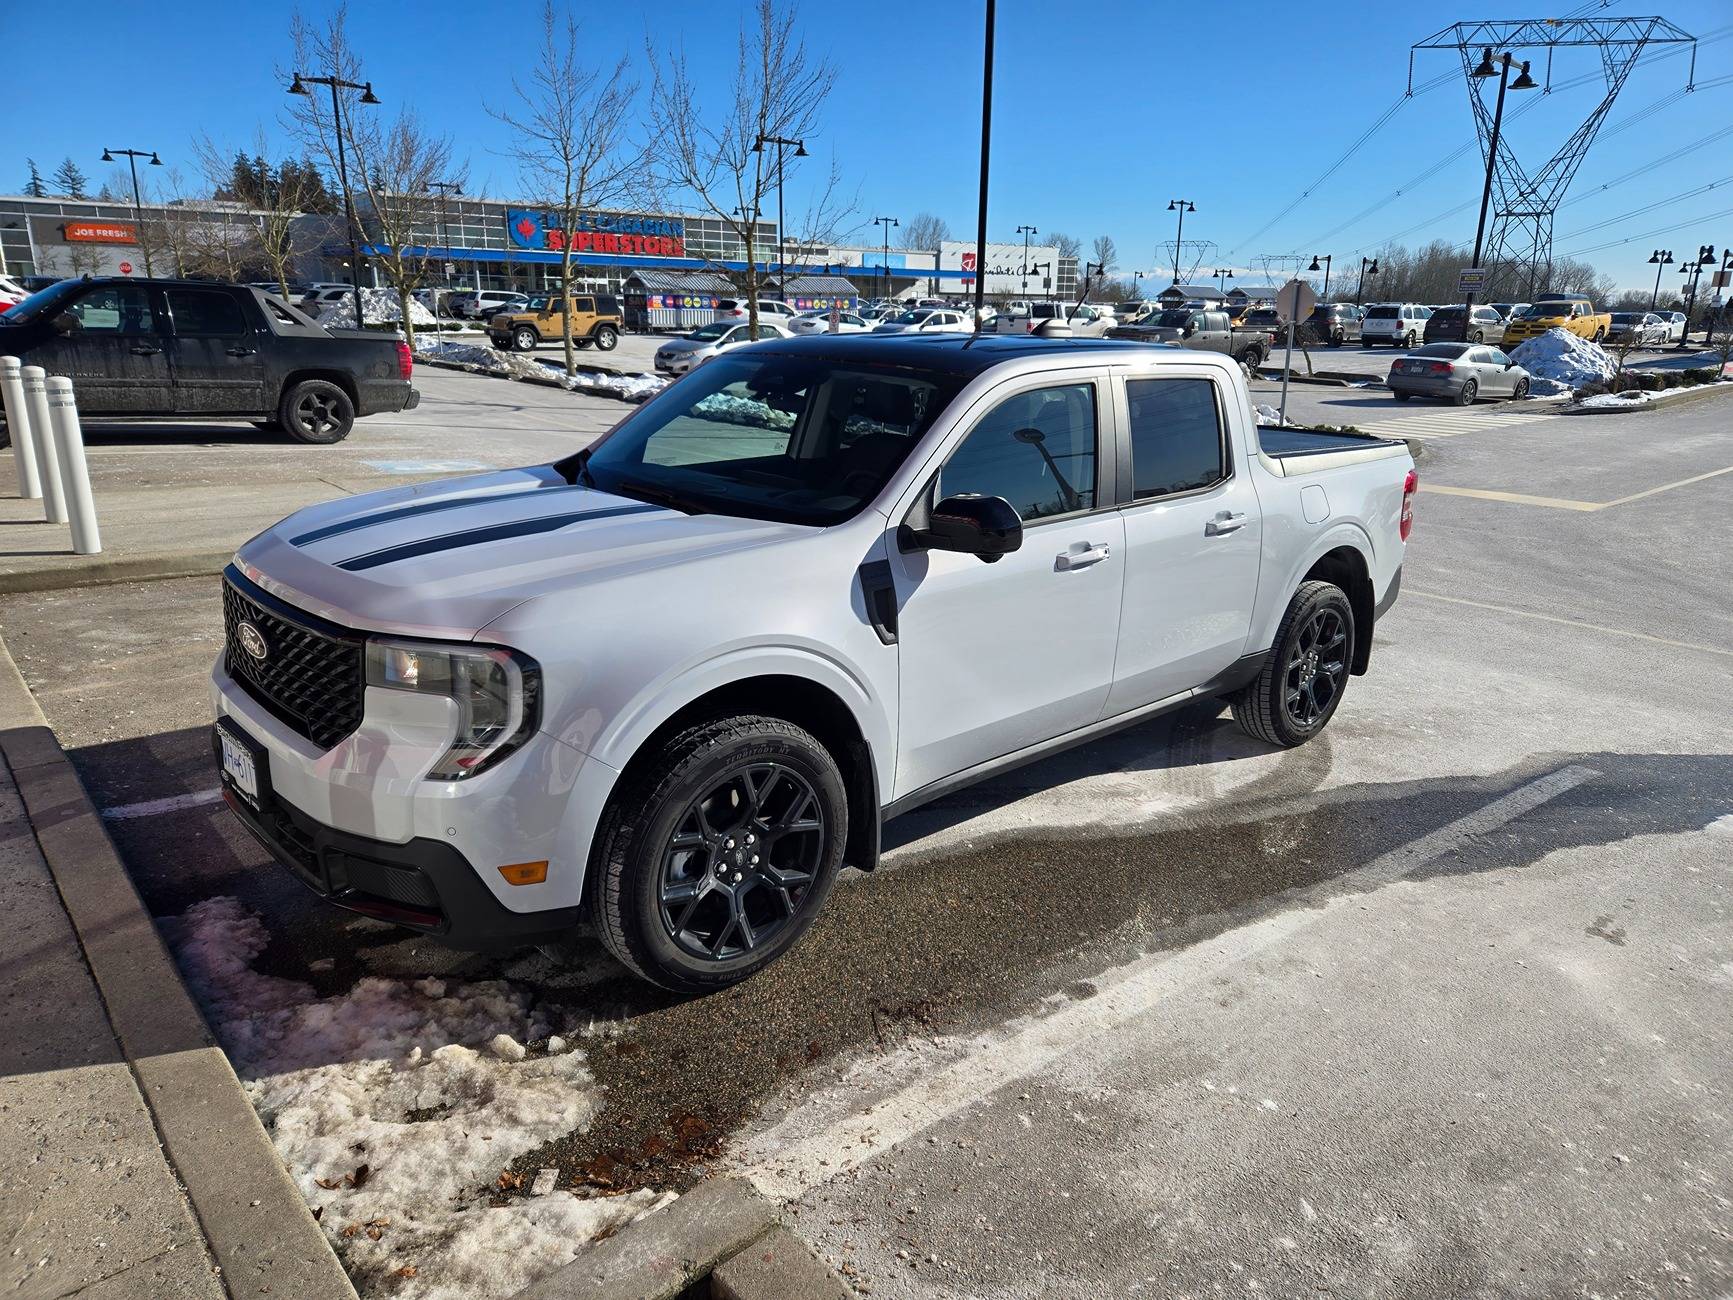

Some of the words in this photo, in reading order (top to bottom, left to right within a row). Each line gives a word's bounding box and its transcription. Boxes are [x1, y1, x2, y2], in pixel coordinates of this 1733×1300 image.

[74, 228, 95, 237] JOE
[96, 229, 128, 238] FRESH
[242, 626, 260, 655] Ford
